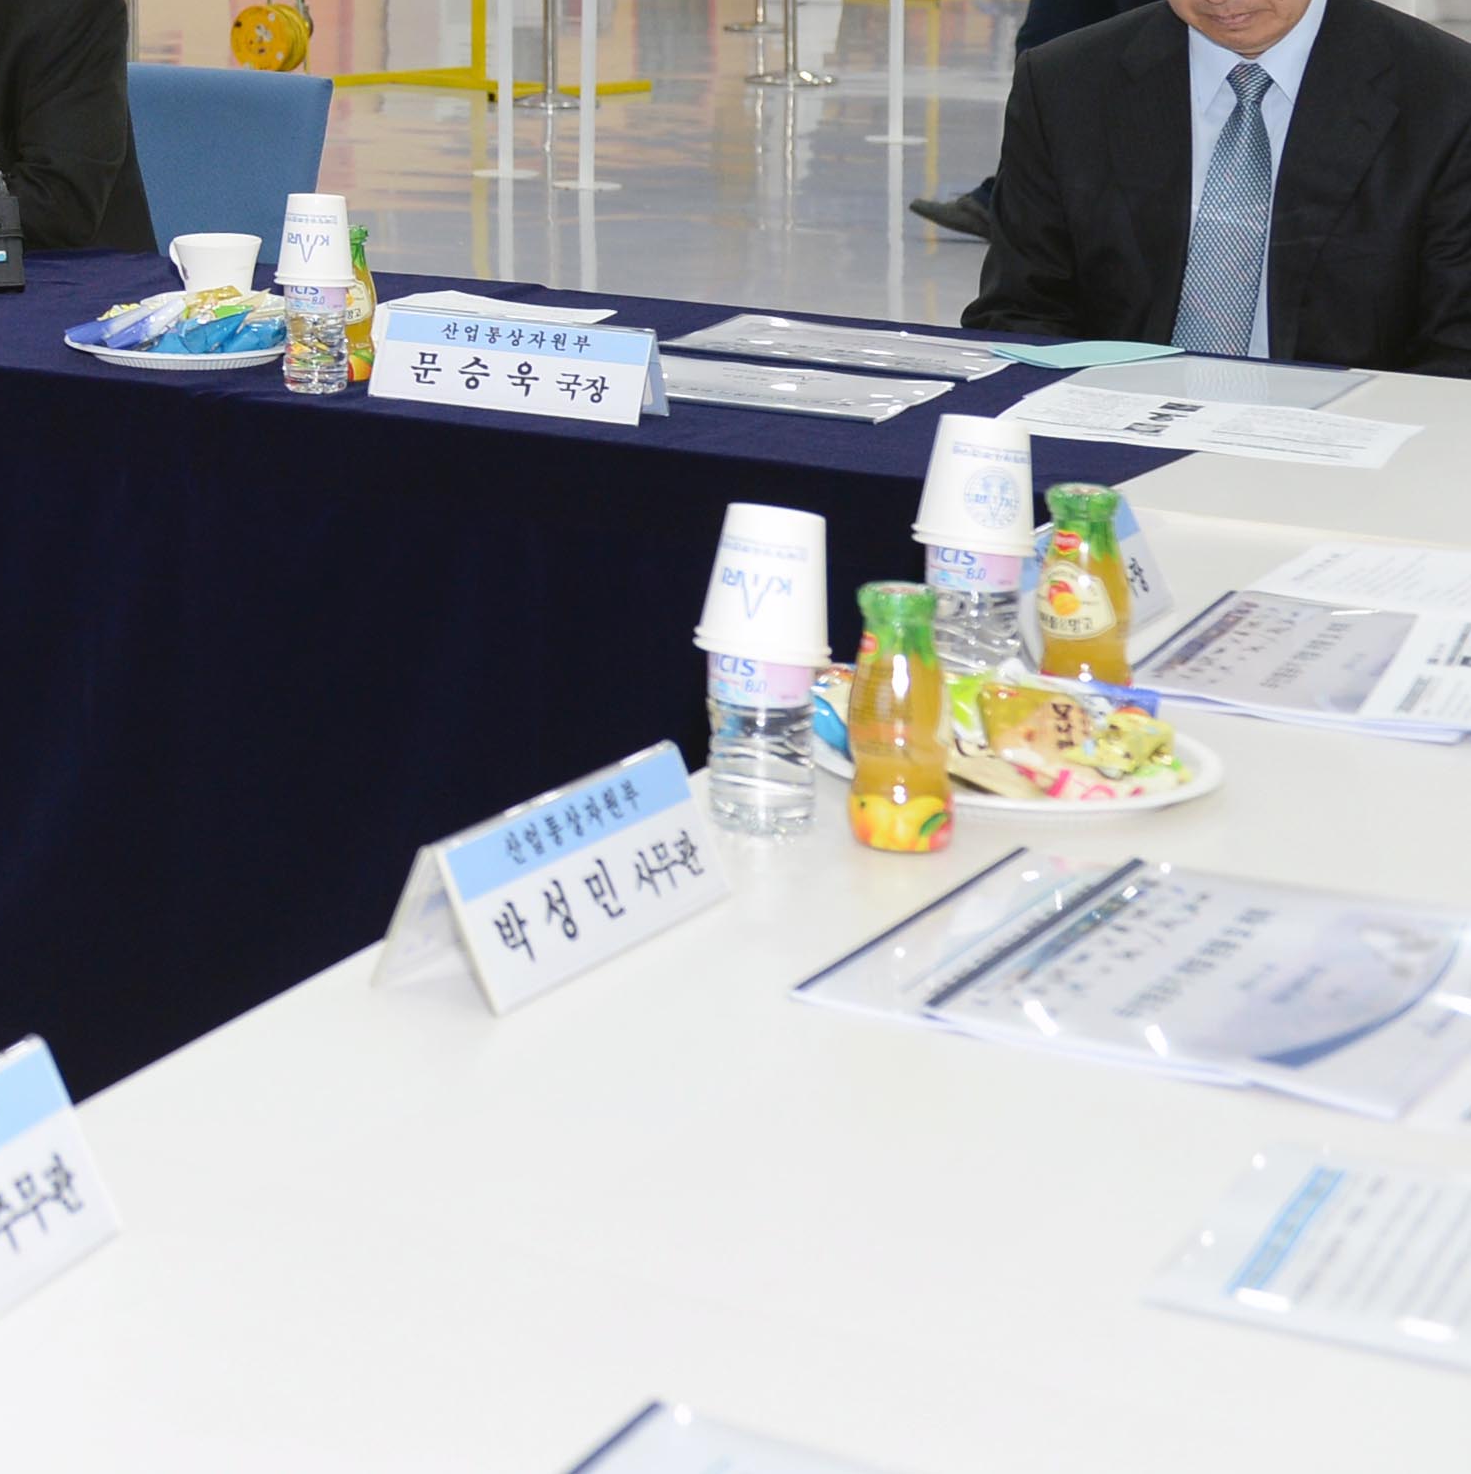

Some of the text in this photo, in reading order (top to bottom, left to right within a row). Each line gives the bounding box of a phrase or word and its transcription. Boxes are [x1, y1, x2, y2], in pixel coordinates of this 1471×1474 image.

[441, 322, 592, 354] 산업통상자원부
[410, 351, 610, 403] 문승욱 국장
[504, 778, 640, 864] 산업통상자원부
[634, 830, 706, 899] 사무관
